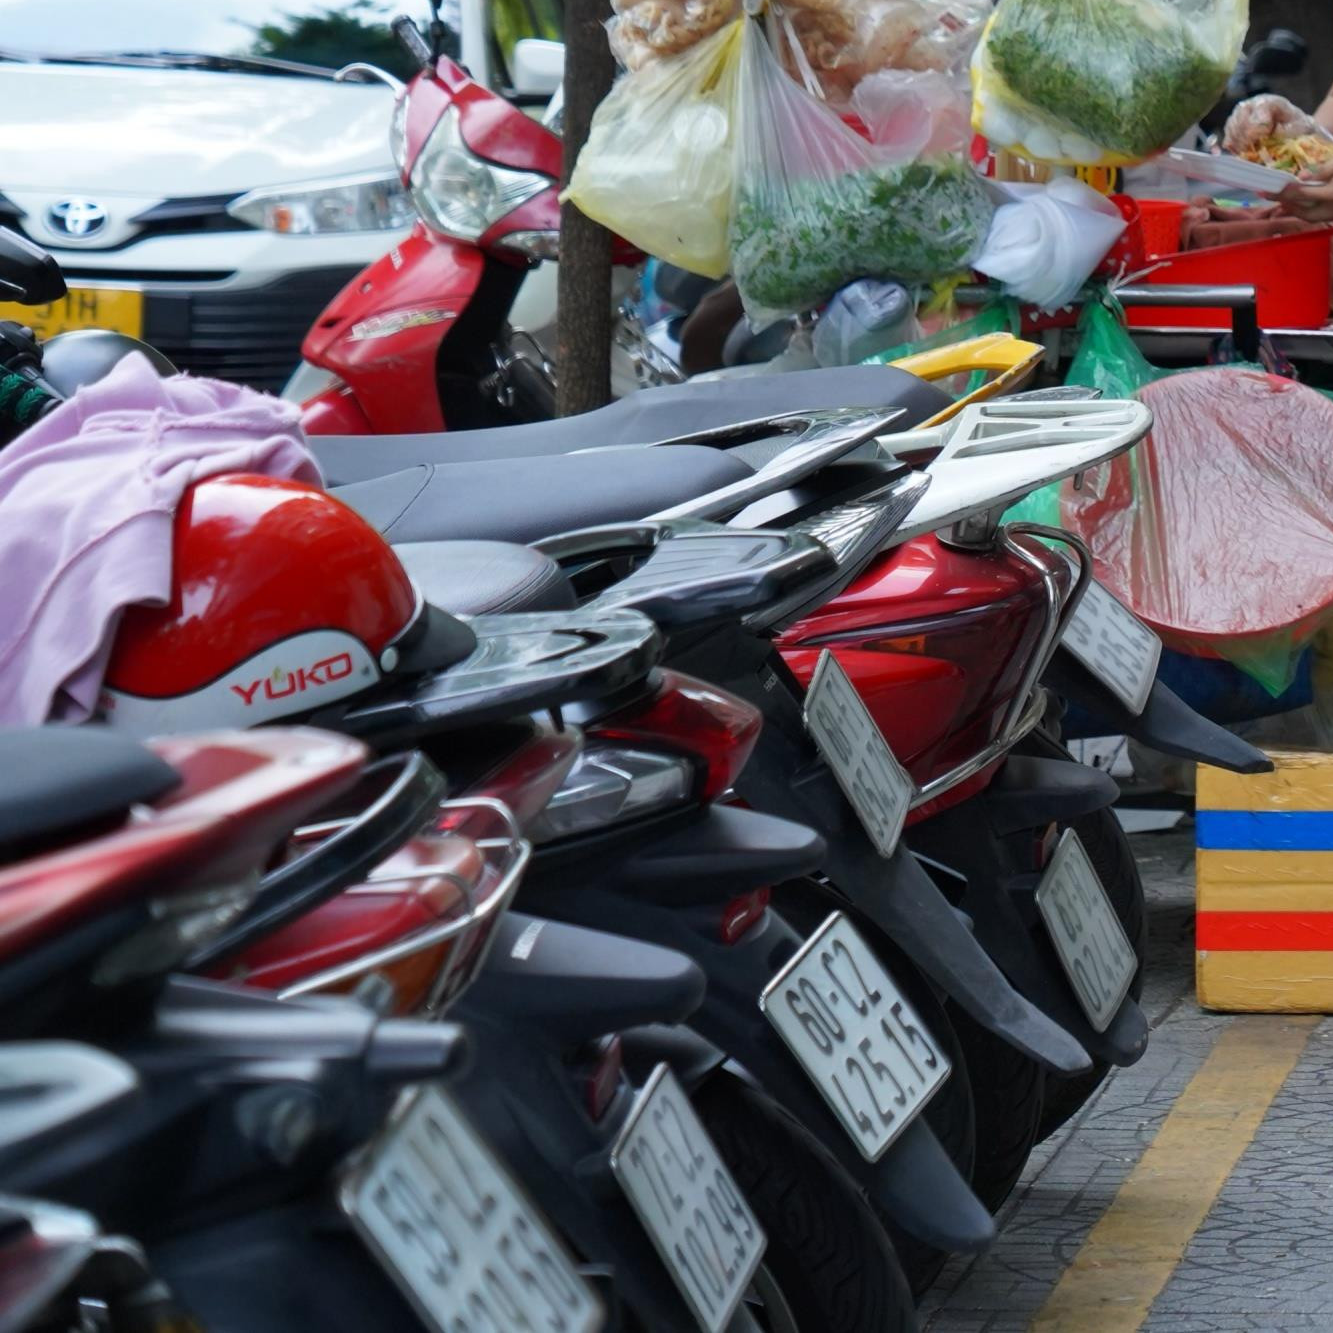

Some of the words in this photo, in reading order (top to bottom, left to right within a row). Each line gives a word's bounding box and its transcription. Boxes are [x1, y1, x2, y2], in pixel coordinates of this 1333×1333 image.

[785, 938, 882, 1056] 60-C2
[830, 1001, 938, 1139] 425.15
[629, 1095, 705, 1227] 72-C2
[674, 1168, 754, 1317] 102.99
